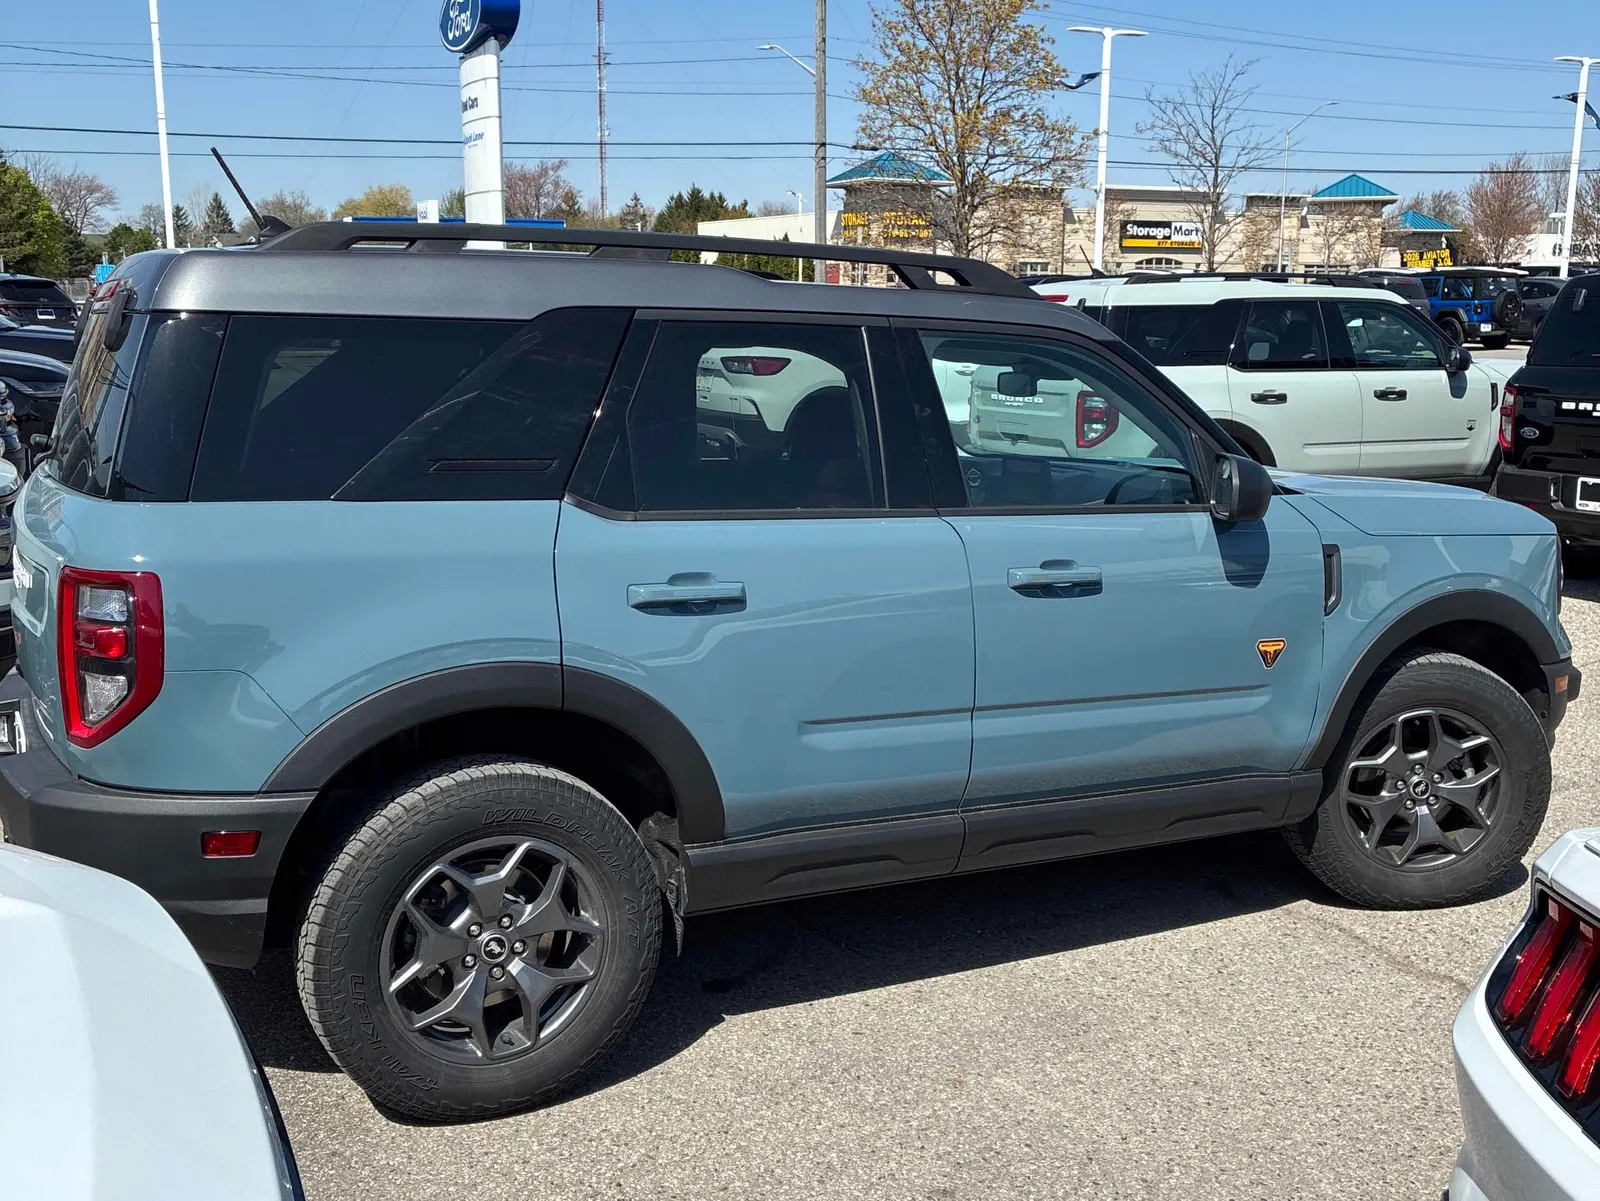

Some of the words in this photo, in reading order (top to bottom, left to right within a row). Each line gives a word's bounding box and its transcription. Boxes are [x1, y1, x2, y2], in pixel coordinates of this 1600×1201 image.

[447, 0, 472, 41] Ford
[1126, 223, 1171, 239] Storage
[1173, 224, 1199, 237] Mart
[1422, 249, 1450, 260] AVIATOR
[991, 393, 1044, 404] BRONCO
[482, 807, 631, 883] WILDPEAK
